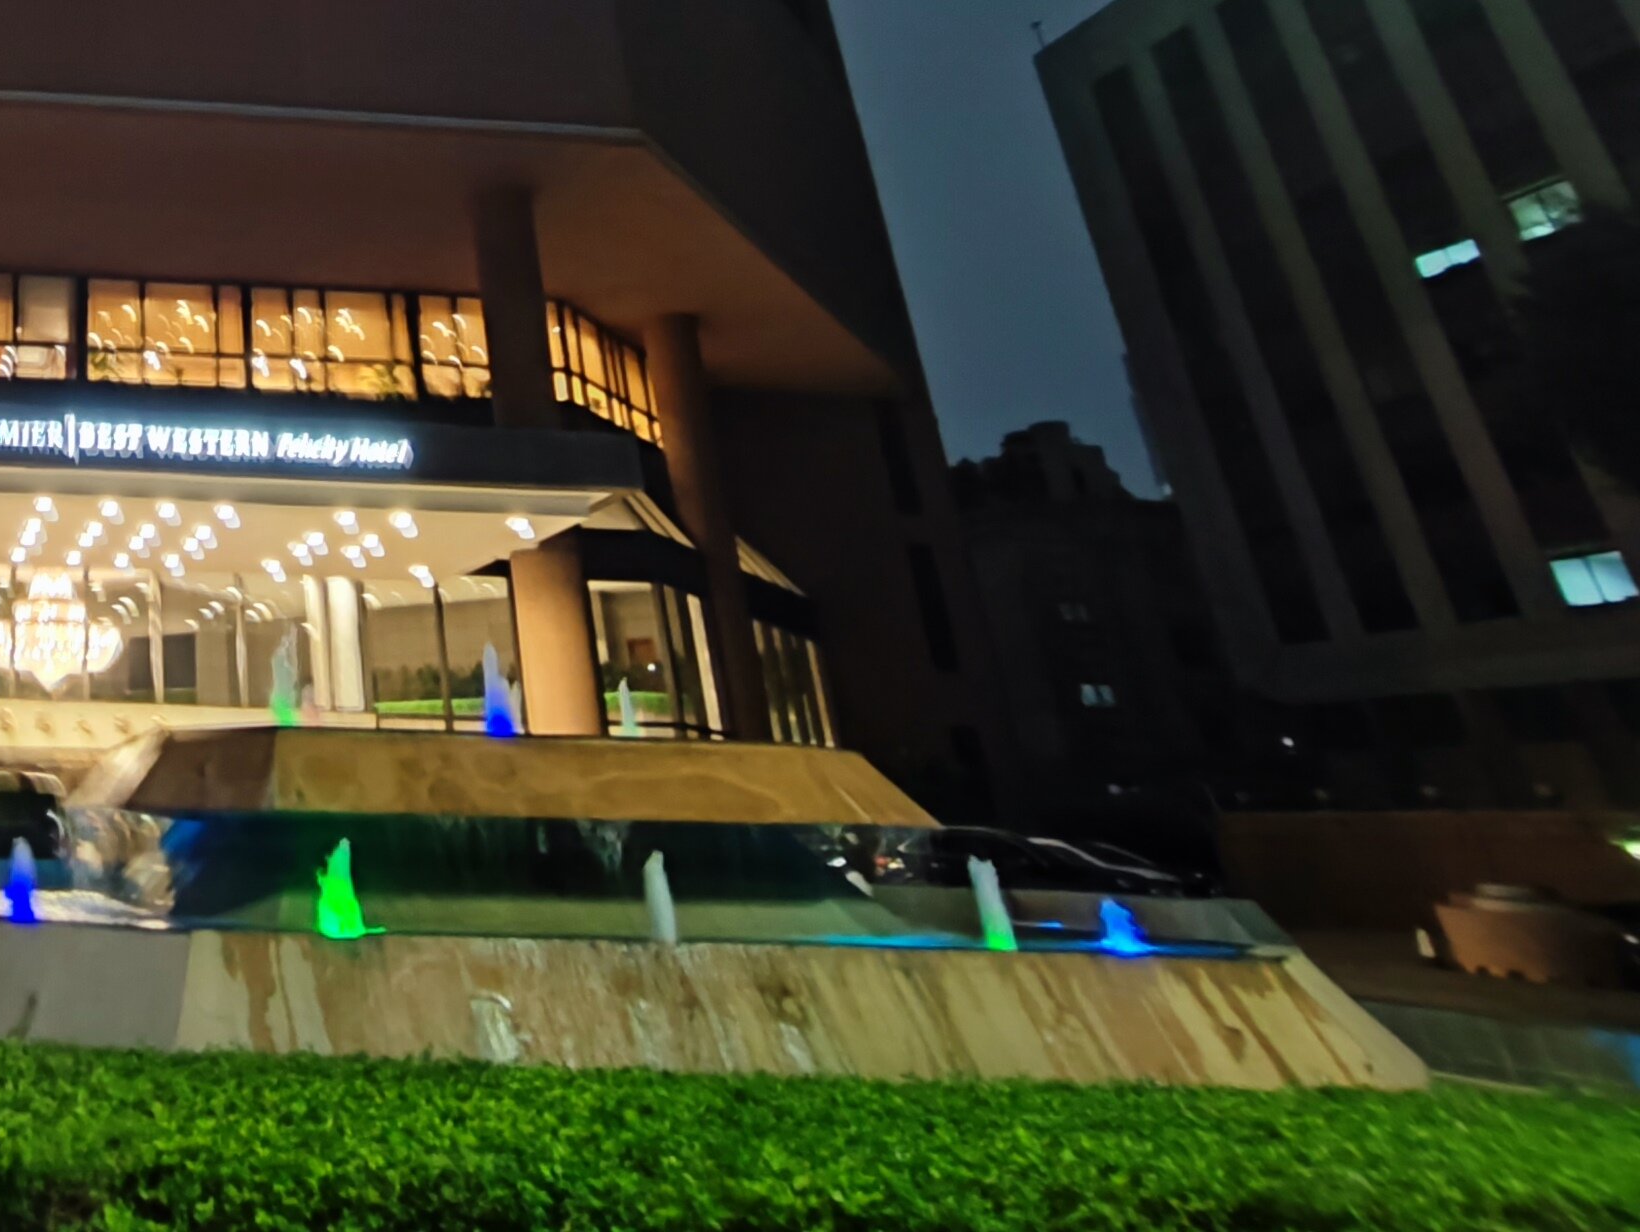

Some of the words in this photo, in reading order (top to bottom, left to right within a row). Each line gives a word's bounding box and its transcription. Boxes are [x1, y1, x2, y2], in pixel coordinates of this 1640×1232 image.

[78, 420, 144, 452] BEST
[146, 424, 270, 458] WESTERN
[350, 436, 410, 466] Hotel
